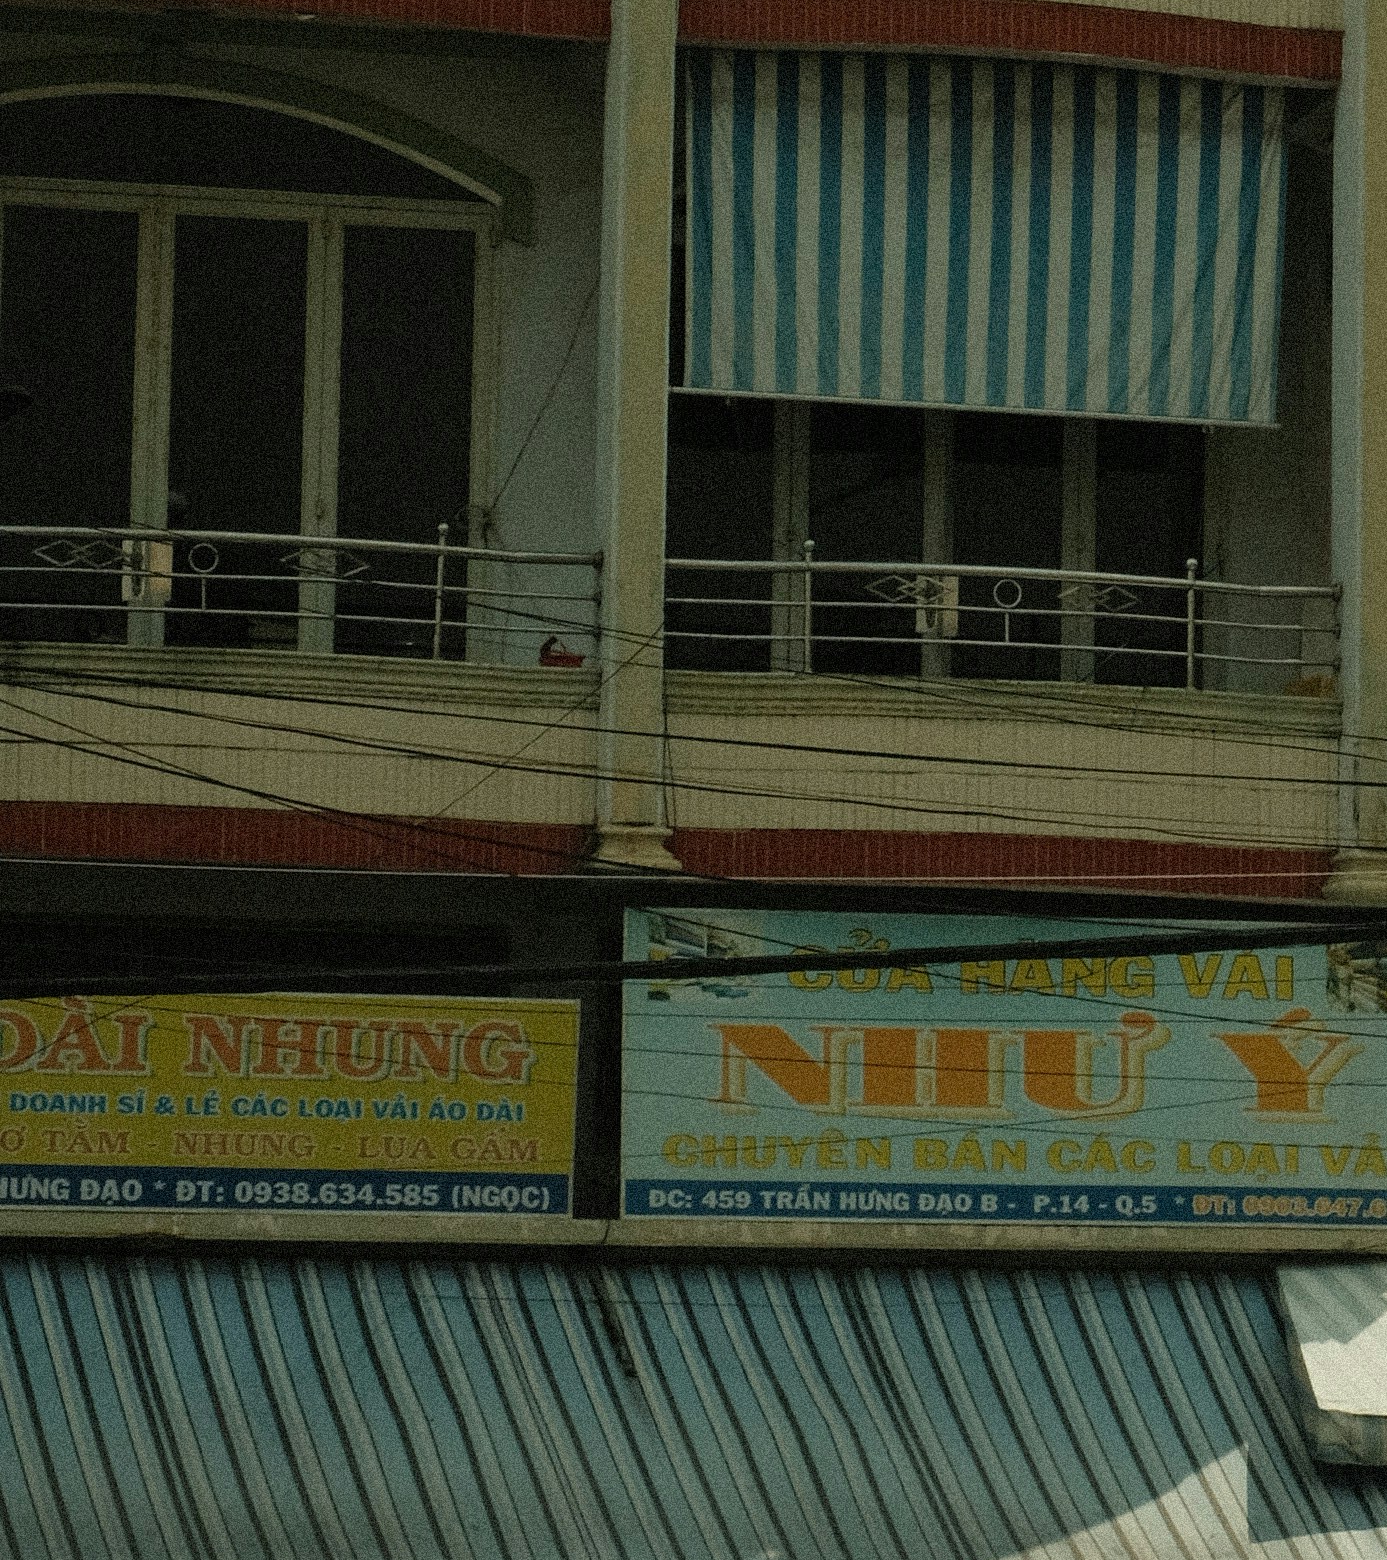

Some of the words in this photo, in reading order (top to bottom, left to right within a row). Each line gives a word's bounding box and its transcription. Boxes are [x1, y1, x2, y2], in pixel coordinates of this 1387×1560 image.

[184, 1012, 537, 1085] NHUNG
[707, 1011, 1166, 1119] NHƯ
[1212, 1008, 1362, 1121] Ý
[9, 1092, 107, 1115] DOANH
[154, 1095, 176, 1116] &
[230, 1092, 288, 1118] CÁC
[298, 1098, 363, 1124] LOẠI
[173, 1130, 316, 1159] NHUNG
[661, 1128, 892, 1171] CHUYÊN
[912, 1129, 1028, 1173] BÁN
[1045, 1130, 1157, 1175] CÁC
[1176, 1139, 1300, 1182] LOẠI
[79, 1178, 144, 1205] ĐẠO
[175, 1180, 225, 1203] ĐT:
[233, 1180, 441, 1208] 0938.634.585
[451, 1184, 552, 1212] (NGỌC)
[699, 1188, 752, 1211] 459
[838, 1187, 911, 1214] HƯNG
[917, 1191, 973, 1218] ĐẠO
[979, 1194, 999, 1213] B
[1032, 1194, 1090, 1216] P.14
[1114, 1194, 1157, 1217] Q.5
